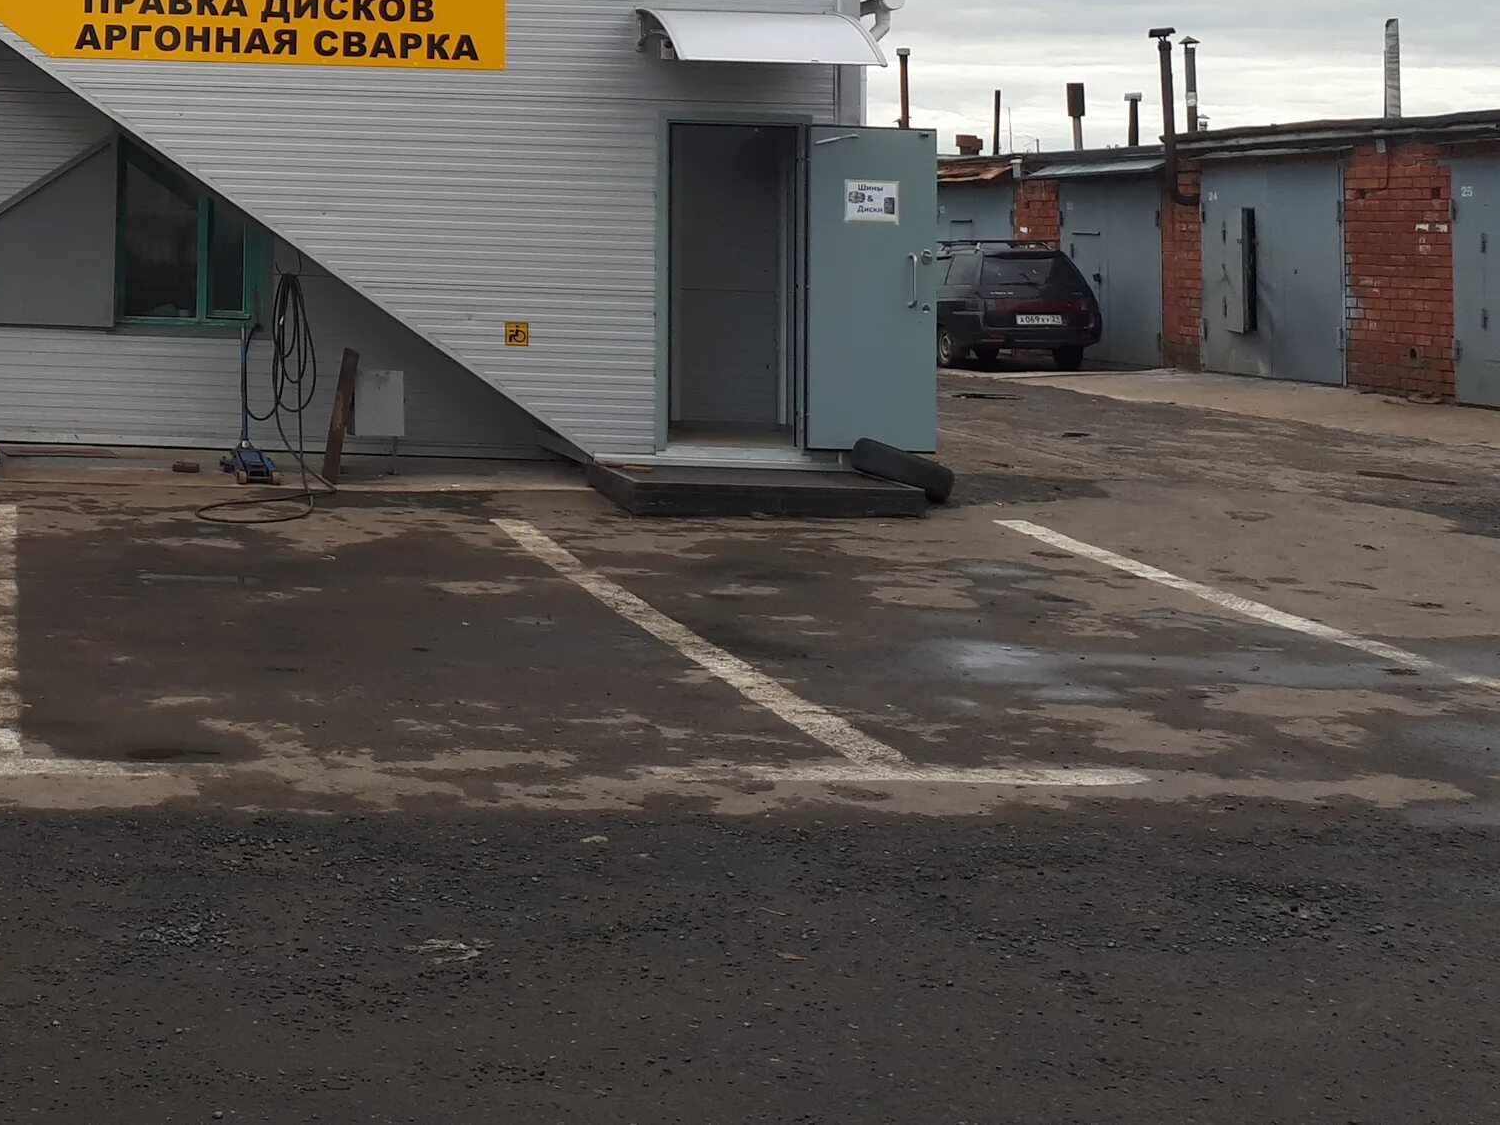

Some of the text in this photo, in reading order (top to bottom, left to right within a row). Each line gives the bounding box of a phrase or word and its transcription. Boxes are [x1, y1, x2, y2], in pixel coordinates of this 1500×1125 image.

[74, 24, 480, 62] АРГОННАЯ СВАРКА
[857, 205, 882, 213] Диски
